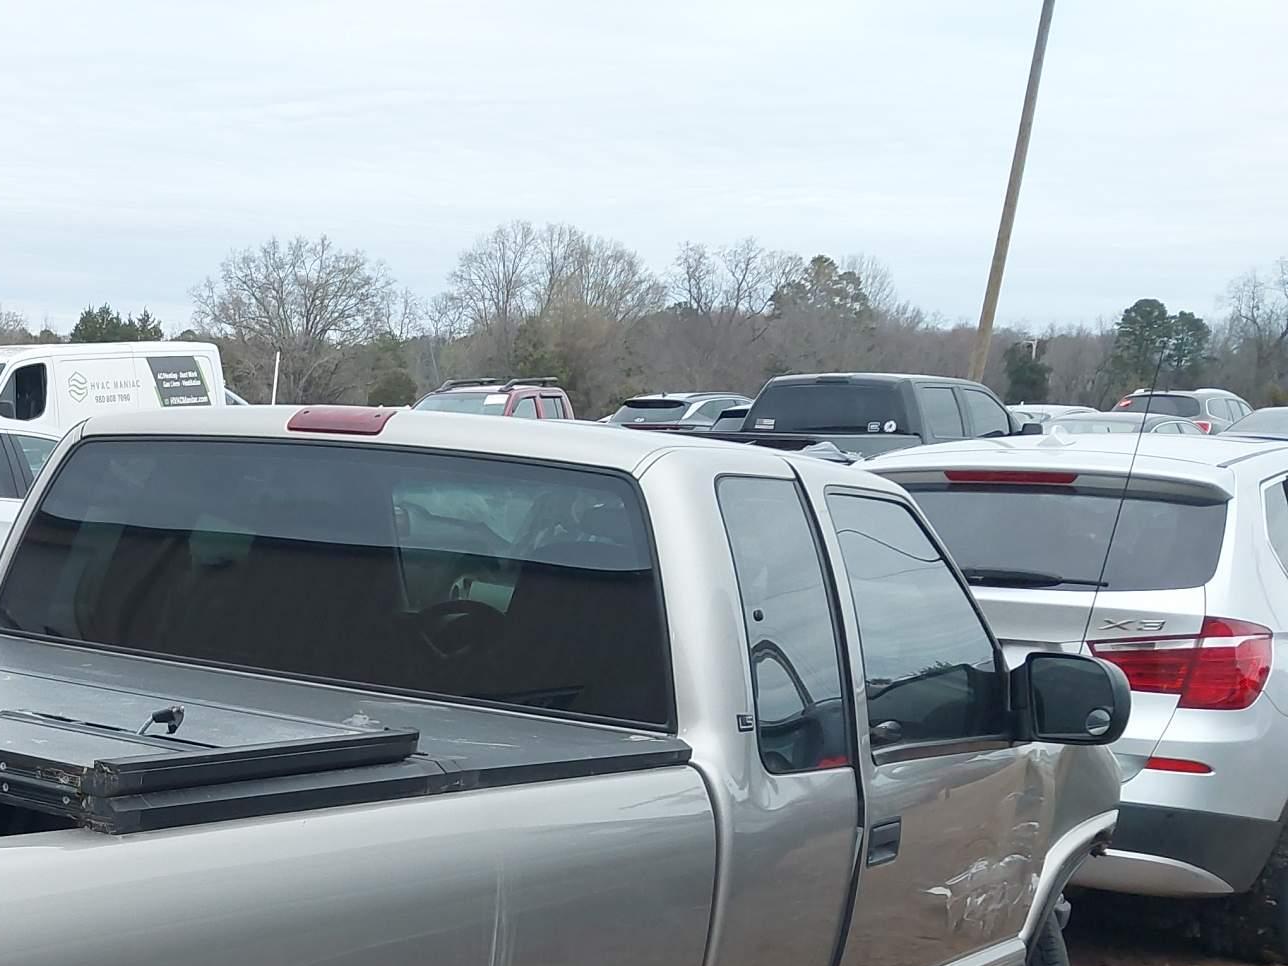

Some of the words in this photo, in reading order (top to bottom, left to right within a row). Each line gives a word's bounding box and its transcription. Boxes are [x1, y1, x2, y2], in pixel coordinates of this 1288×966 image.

[90, 381, 110, 390] HVAC
[113, 379, 141, 389] MANIAC
[1097, 618, 1167, 632] X3
